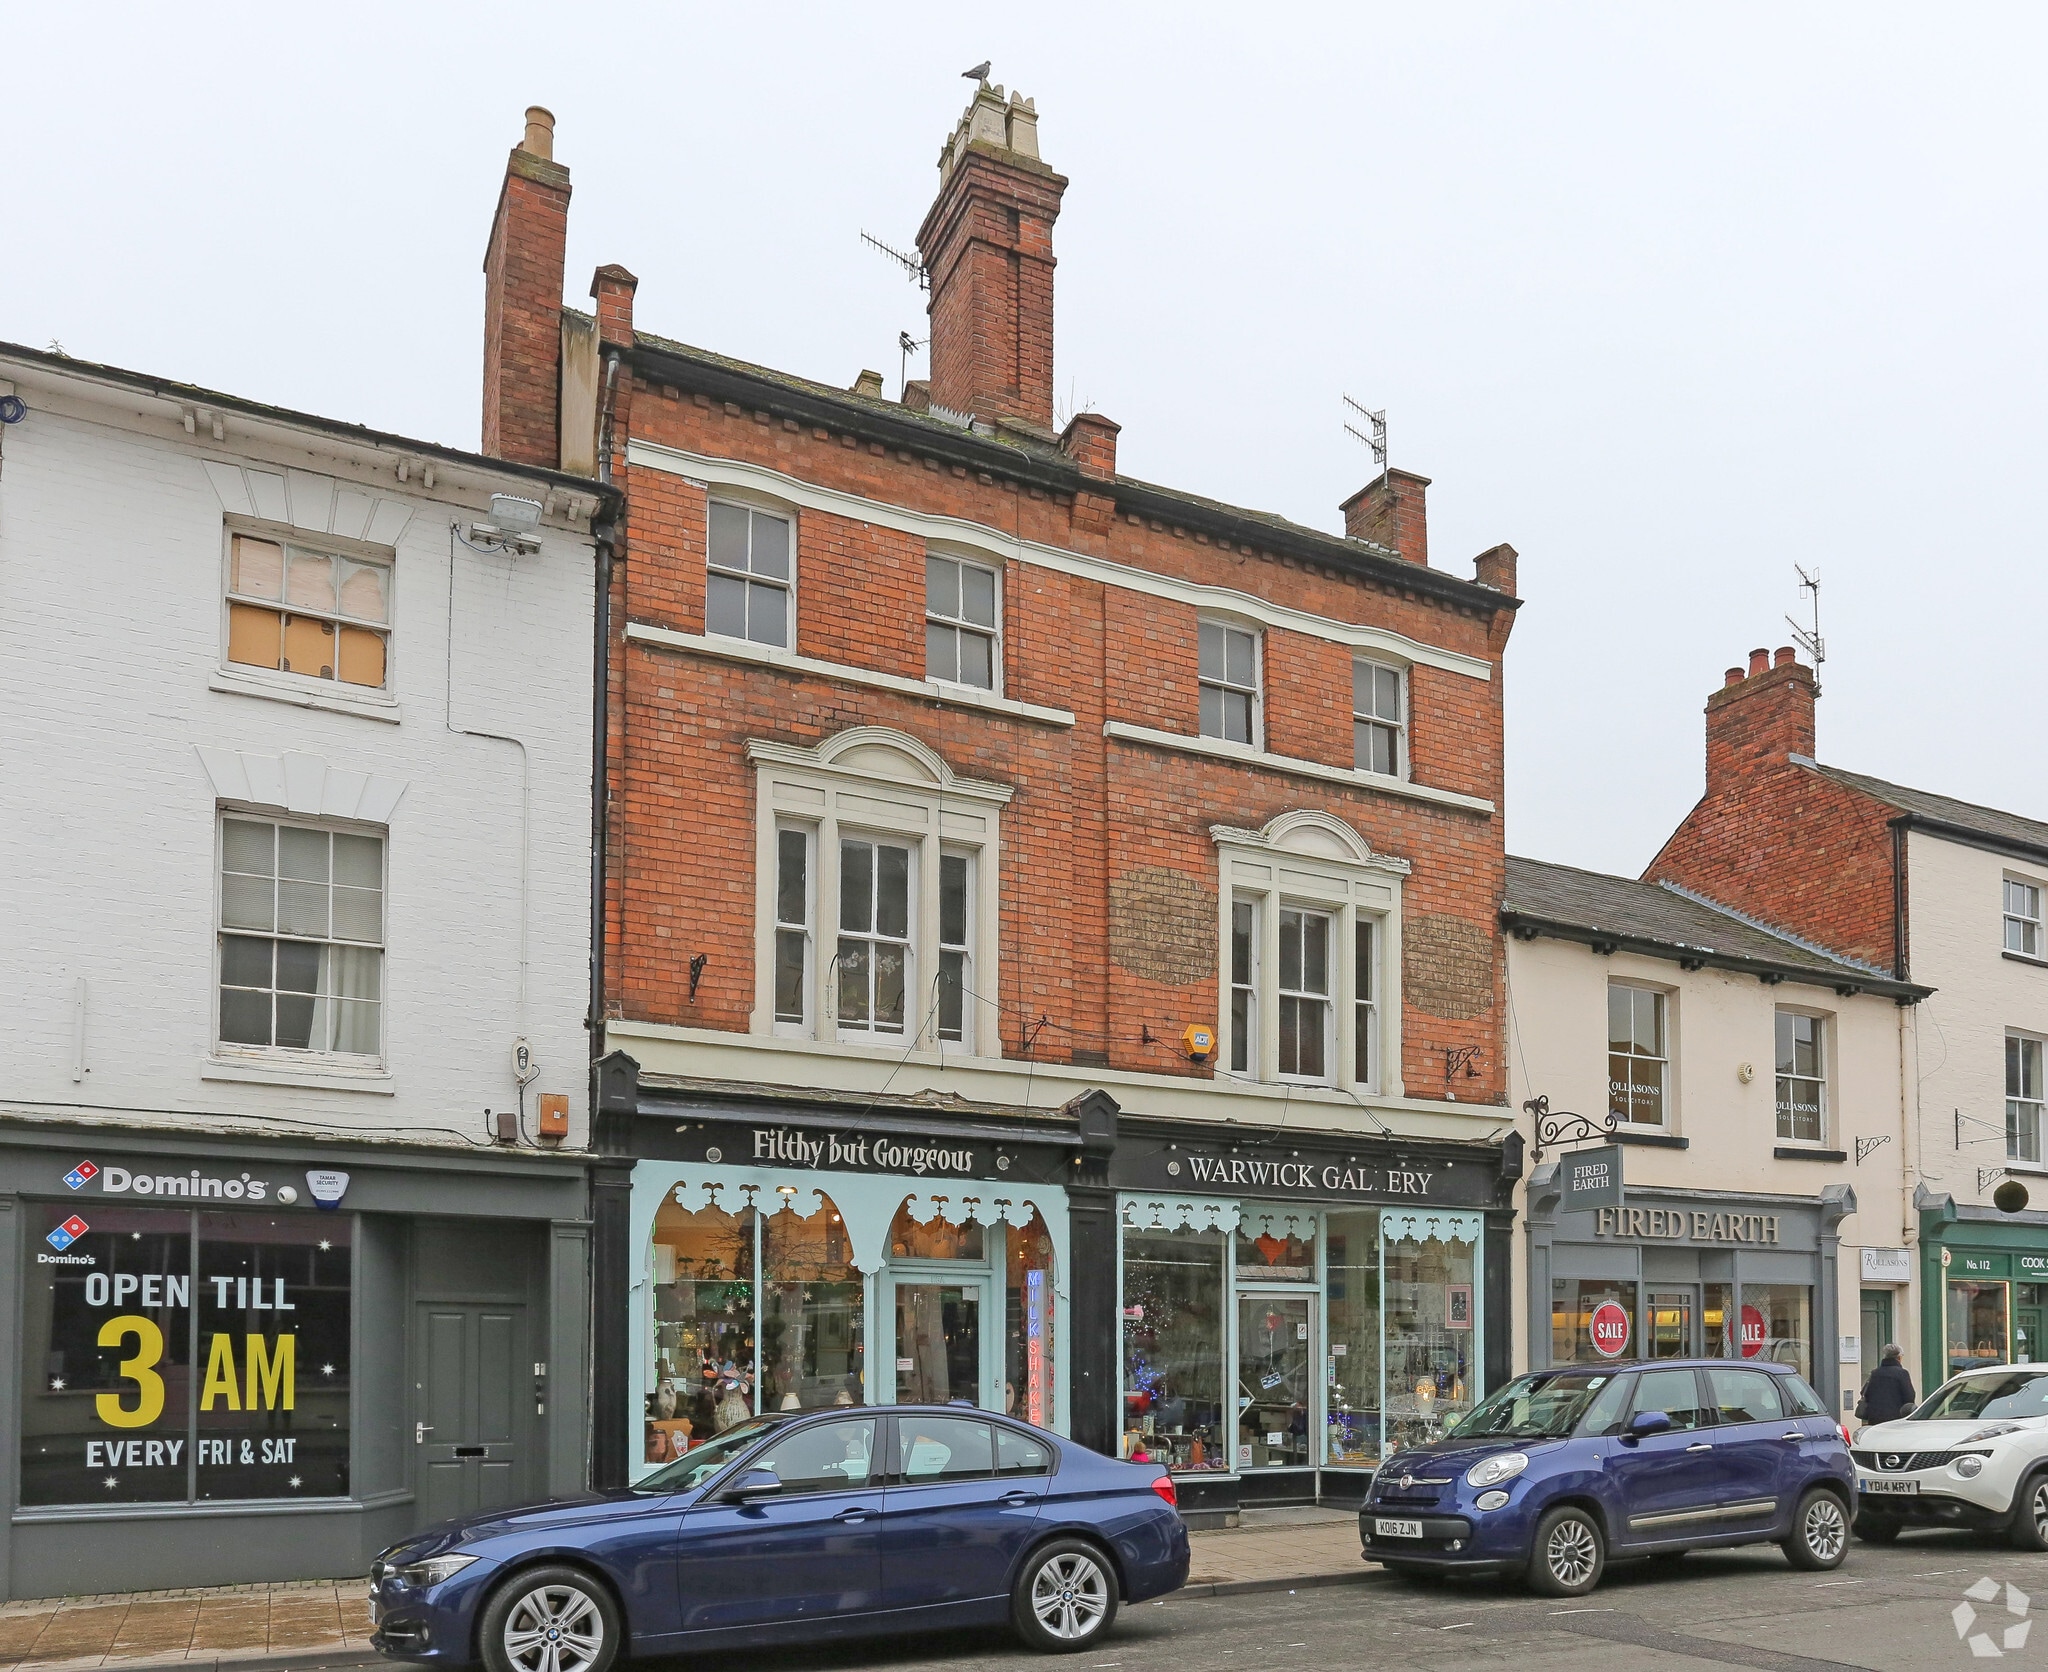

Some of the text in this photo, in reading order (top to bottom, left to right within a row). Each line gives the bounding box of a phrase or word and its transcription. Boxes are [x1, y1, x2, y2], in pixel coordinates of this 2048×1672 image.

[1775, 1100, 1818, 1114] OLLASONS
[752, 1128, 975, 1176] Filthy but Gorgeous
[1188, 1157, 1317, 1189] WARWICK
[1573, 1163, 1608, 1179] FIRED
[102, 1165, 266, 1200] Domino's
[1573, 1176, 1610, 1192] EARTH
[1595, 1207, 1781, 1244] FIRED EARTH
[37, 1253, 96, 1265] Domino's
[1980, 1260, 1990, 1270] 112
[2021, 1256, 2045, 1269] COOK
[85, 1272, 296, 1310] OPEN TILL
[1597, 1322, 1624, 1339] SALE
[1741, 1323, 1761, 1341] ALE
[95, 1314, 295, 1428] 3 AM
[86, 1438, 297, 1468] EVERY FRI & SAT
[1400, 1523, 1417, 1536] ZJN
